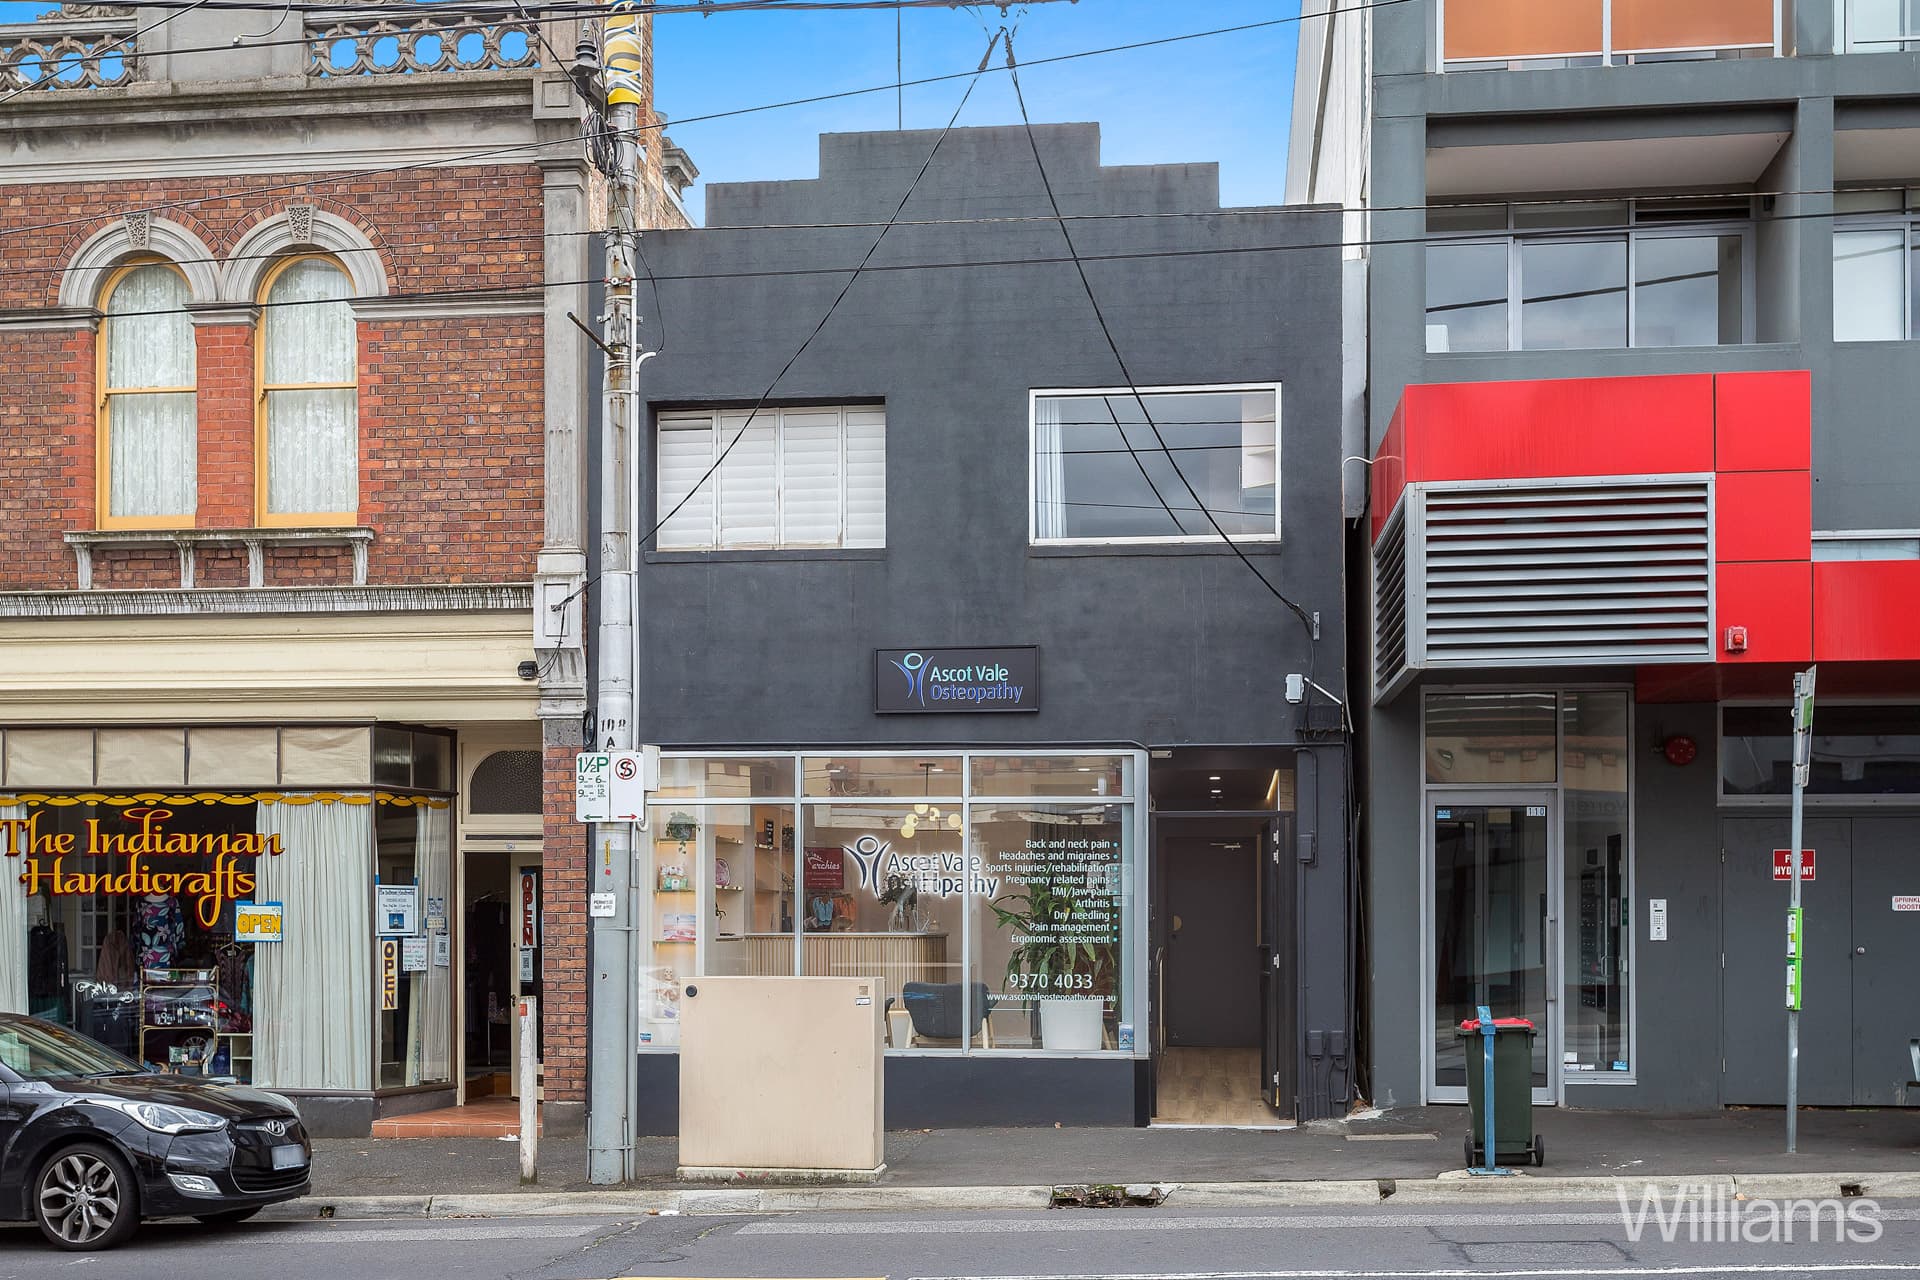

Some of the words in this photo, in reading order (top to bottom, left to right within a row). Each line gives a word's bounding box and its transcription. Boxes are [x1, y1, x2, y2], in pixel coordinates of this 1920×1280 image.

[930, 665, 972, 682] Ascot
[976, 664, 1009, 682] Vale
[930, 681, 1024, 704] Osteopathy
[1527, 807, 1545, 816] 110
[0, 810, 76, 856] The
[84, 807, 285, 857] Indiaman
[1025, 839, 1046, 849] Back
[1048, 839, 1066, 849] and
[1068, 839, 1089, 849] neck
[1091, 840, 1110, 850] pain
[999, 851, 1045, 860] Headaches
[1048, 851, 1065, 860] and
[1067, 851, 1110, 862] migraines
[942, 853, 981, 872] Vae
[985, 863, 1012, 873] Sports
[1015, 863, 1110, 874] injuries/rehabilitation
[1005, 875, 1051, 886] Pregnancy
[1053, 875, 1087, 884] related
[1088, 875, 1110, 886] pains
[19, 850, 257, 930] Handicrafts
[1051, 887, 1089, 898] TMJ/Jaw
[1091, 887, 1110, 898] pain
[1075, 899, 1110, 908] Arthritis
[522, 875, 534, 946] OPEN
[1054, 911, 1071, 921] Dry
[1072, 910, 1110, 921] needling
[236, 913, 281, 934] OPEN
[1029, 922, 1048, 931] Pain
[1051, 922, 1110, 933] management
[1011, 934, 1057, 944] Ergonomic
[1059, 934, 1110, 943] assessment
[384, 942, 395, 1008] OPEN
[1009, 973, 1048, 988] 9370
[1054, 973, 1093, 988] 4033
